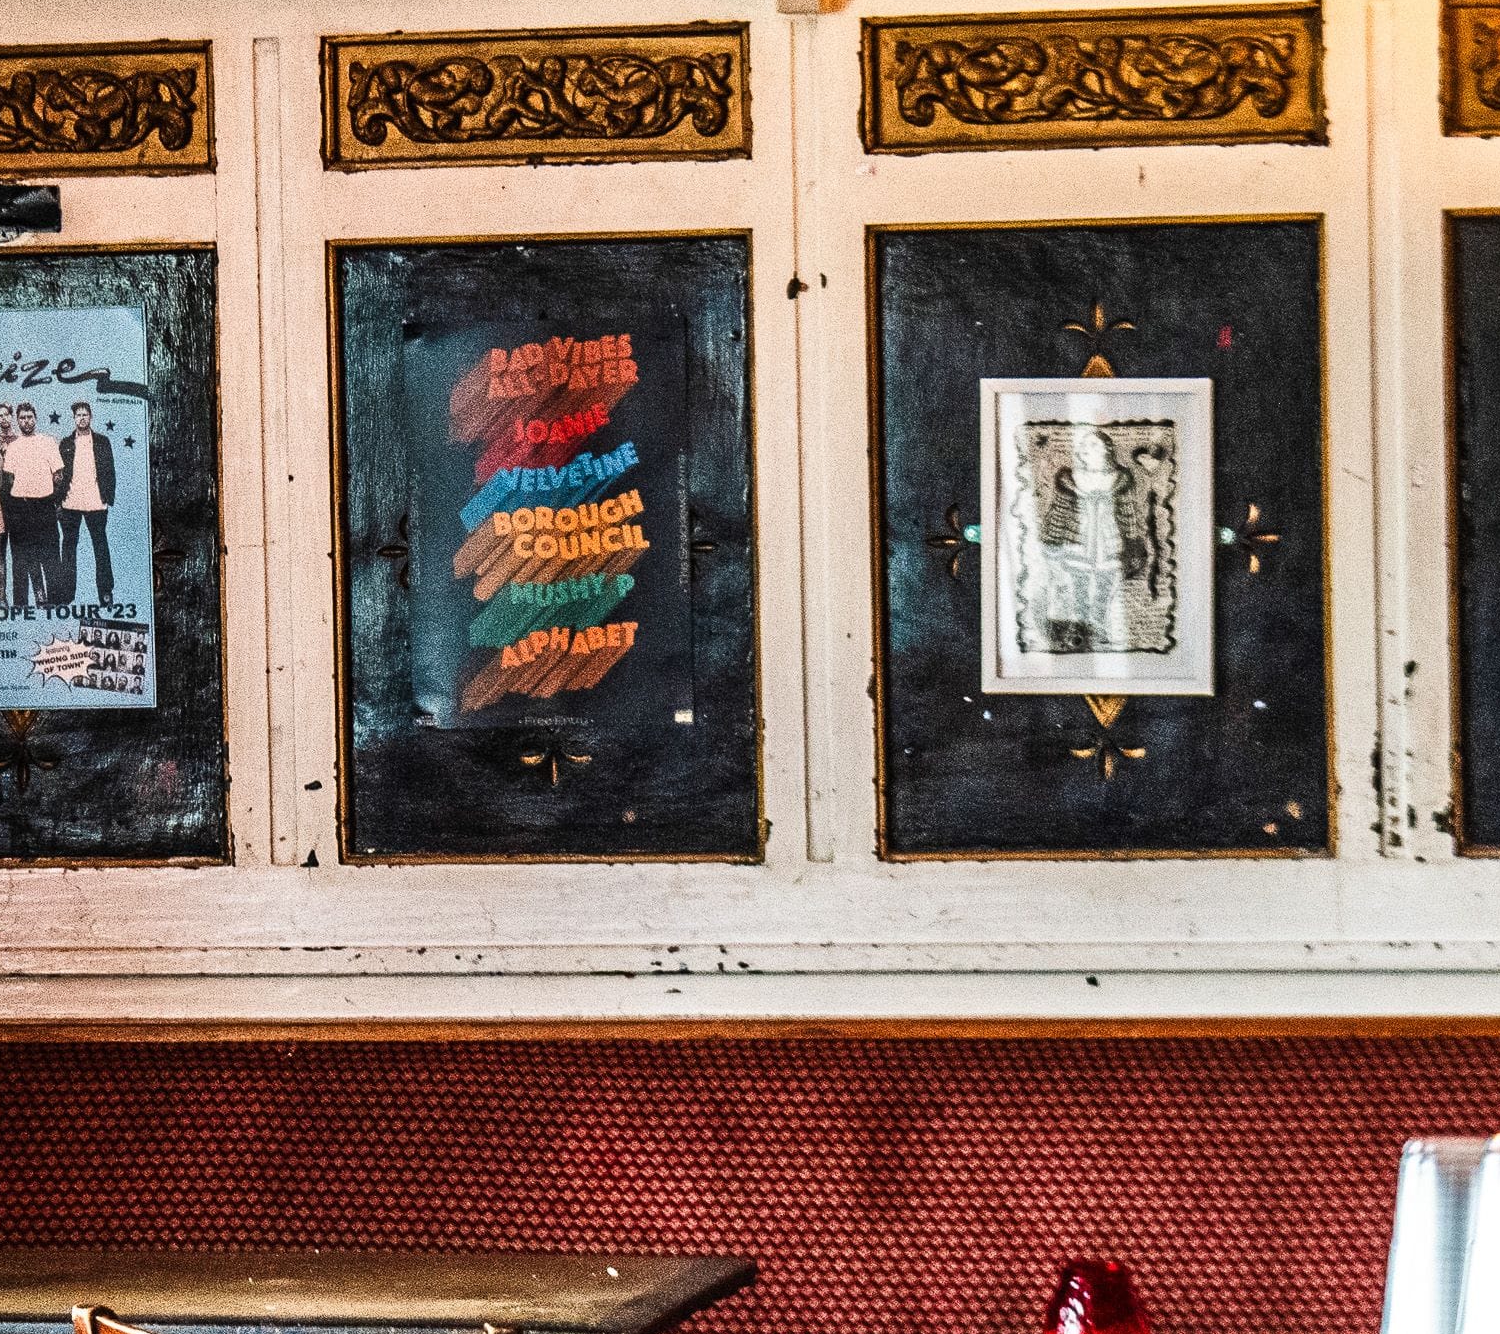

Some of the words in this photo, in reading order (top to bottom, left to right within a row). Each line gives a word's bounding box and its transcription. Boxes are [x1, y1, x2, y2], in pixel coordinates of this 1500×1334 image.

[490, 342, 545, 373] BAD
[550, 333, 633, 366] VIBES
[493, 489, 645, 536] BOROUGH
[513, 524, 650, 560] COUNCIL
[616, 573, 635, 598] P
[42, 604, 100, 619] TOUR
[501, 621, 639, 669] ALPHABET
[44, 665, 56, 674] OF
